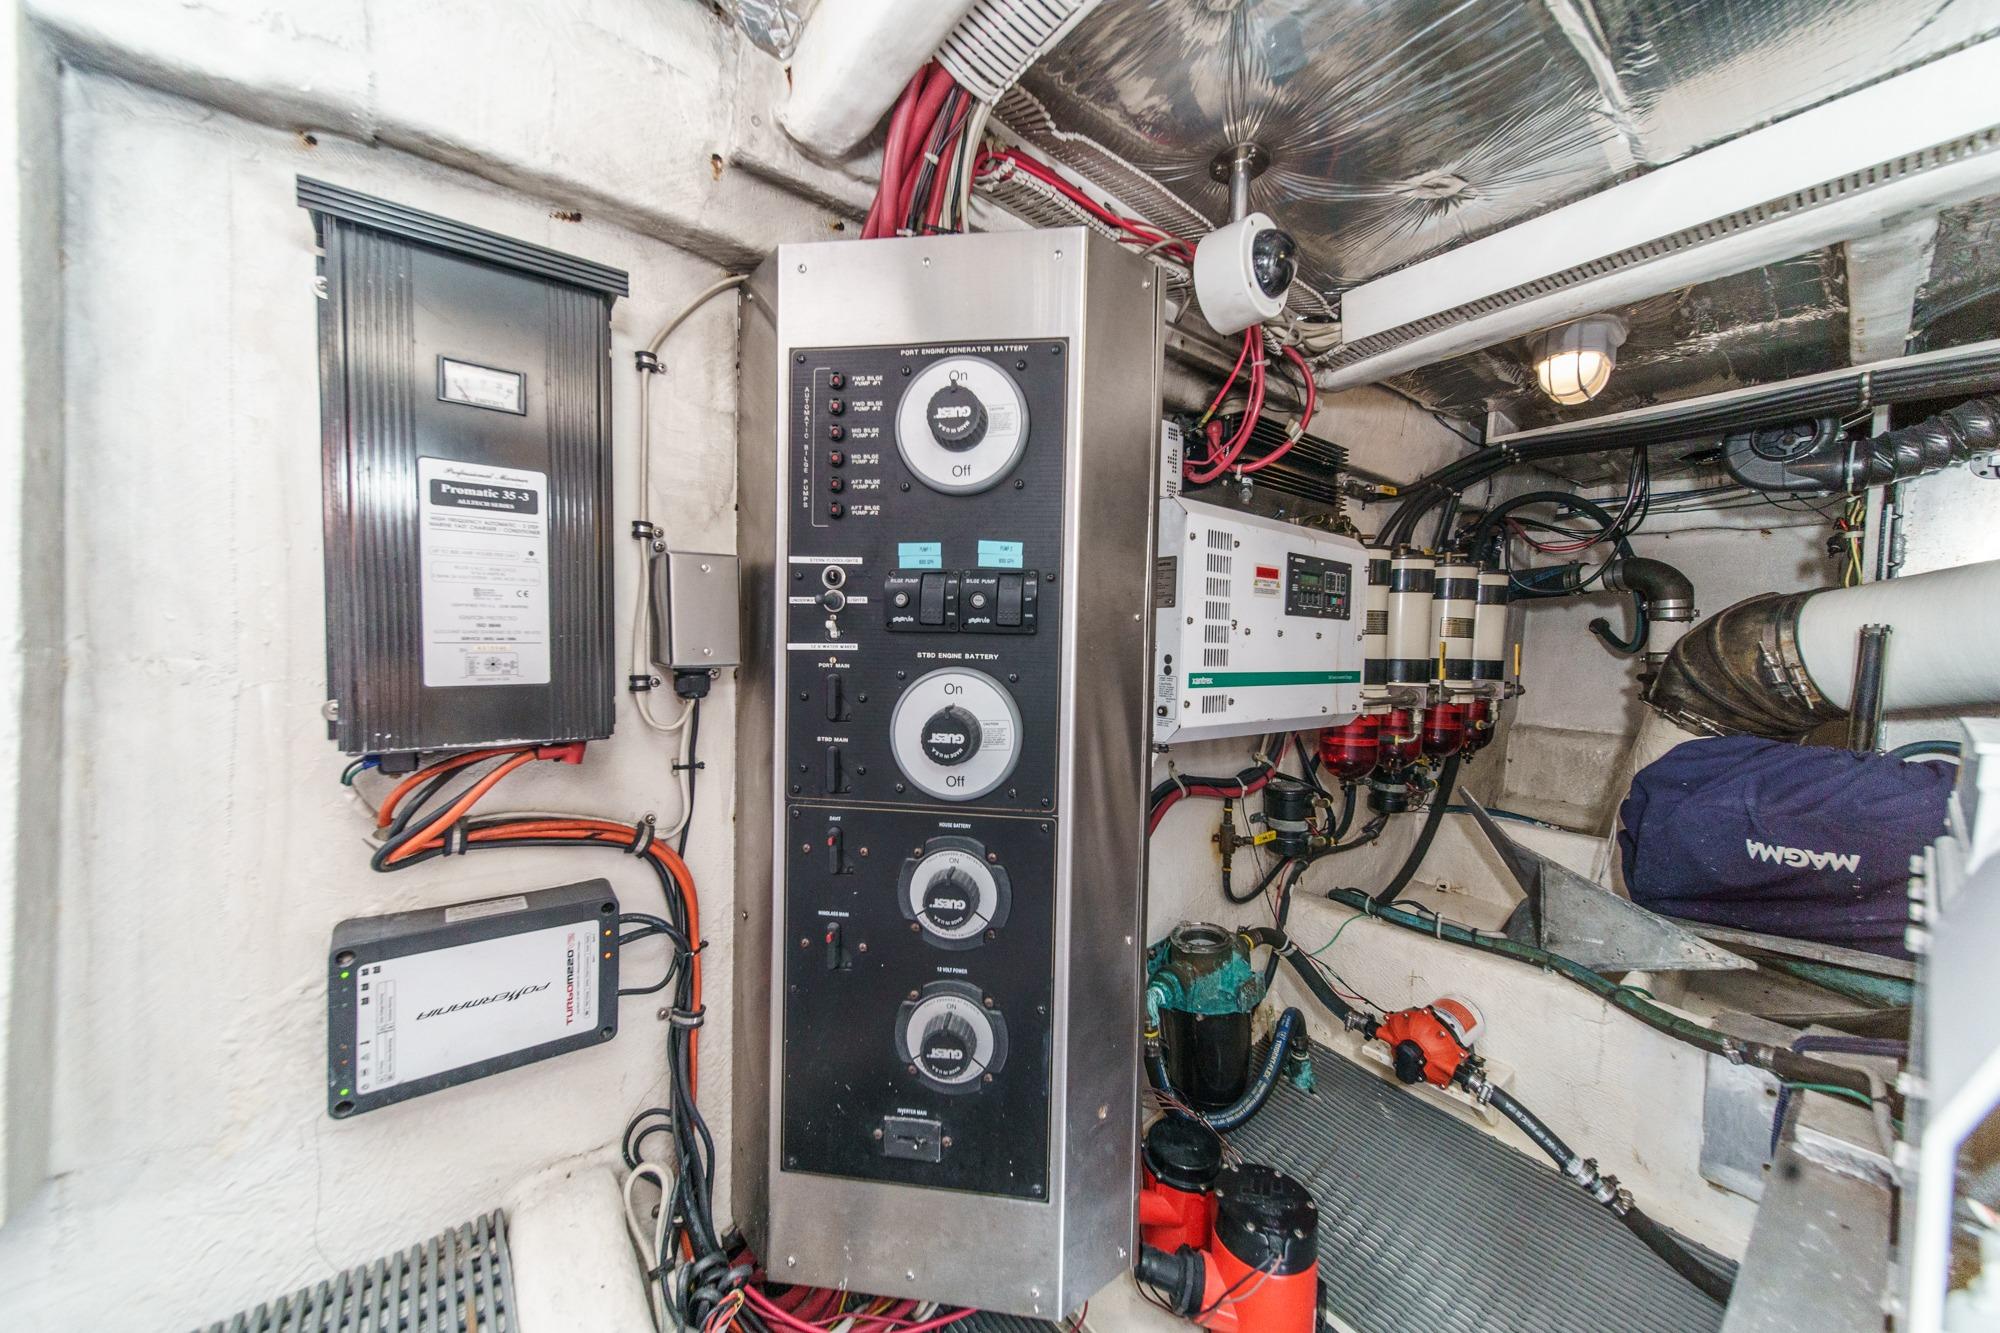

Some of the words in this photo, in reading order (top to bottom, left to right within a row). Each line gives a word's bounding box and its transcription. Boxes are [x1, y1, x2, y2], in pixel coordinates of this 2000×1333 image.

[922, 346, 991, 355] ENGINE/GENERATOR
[949, 370, 968, 381] On
[936, 406, 971, 418] GUEST
[952, 464, 972, 477] Off
[441, 484, 499, 498] Promatic
[502, 490, 516, 500] 35
[518, 493, 530, 502] -3
[944, 683, 963, 695] On
[930, 733, 965, 744] GUEST
[946, 775, 965, 788] Off
[1746, 838, 1860, 873] MAGMA
[932, 898, 966, 910] GUEST
[930, 1048, 962, 1060] GUEST
